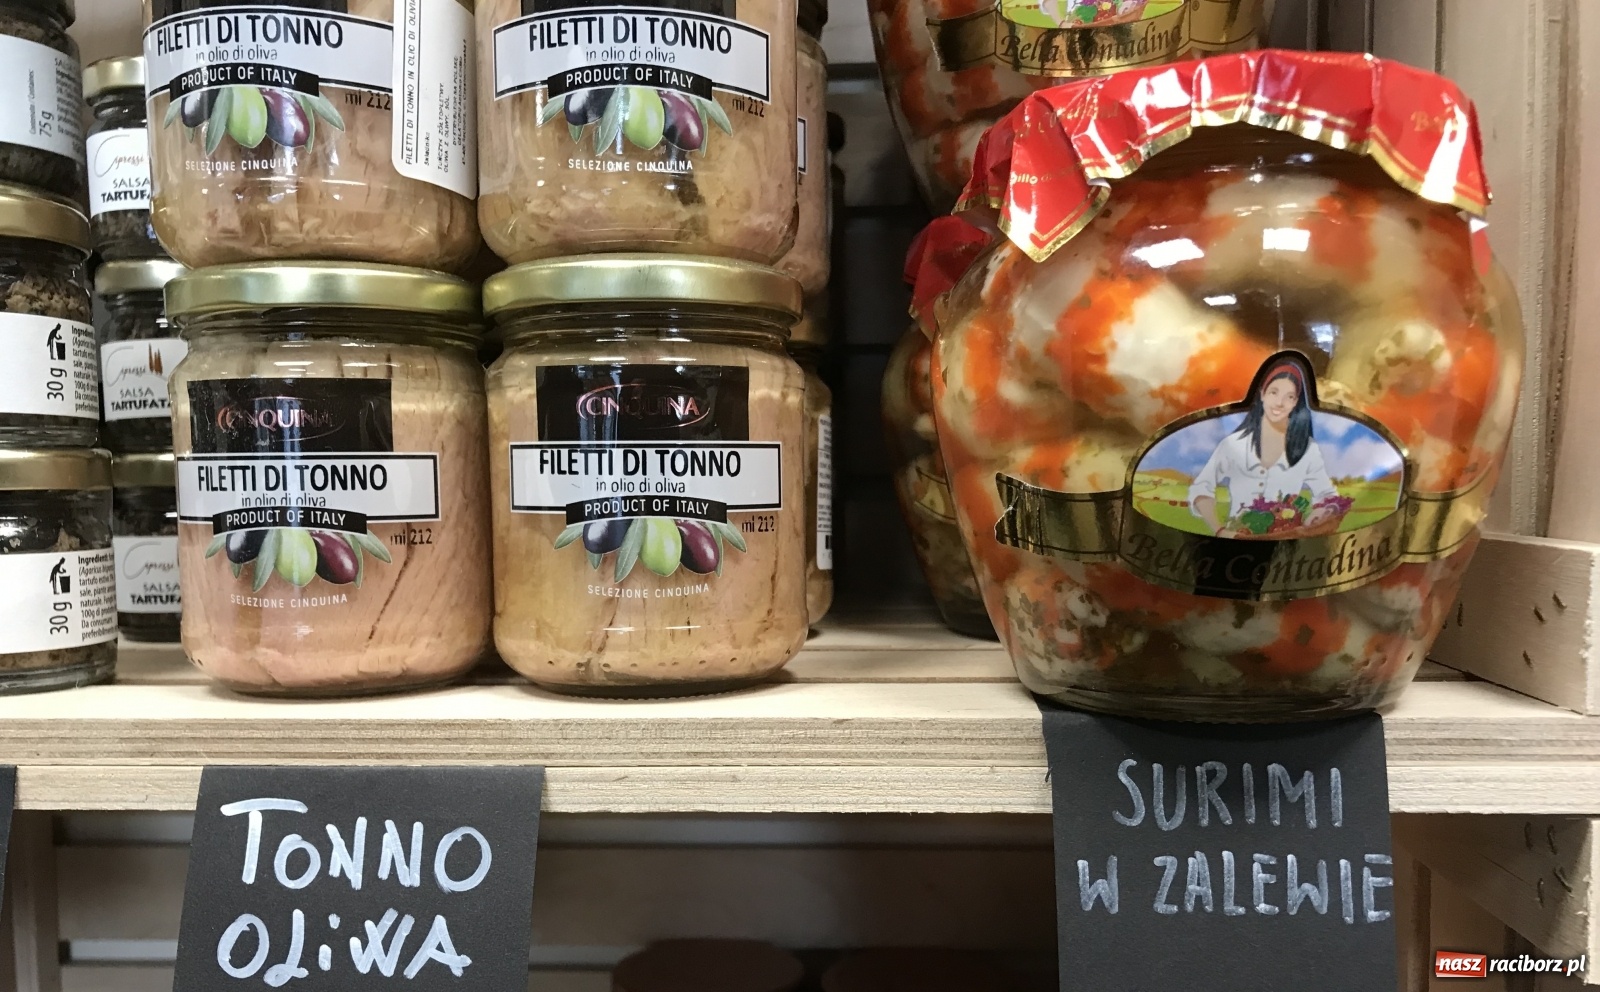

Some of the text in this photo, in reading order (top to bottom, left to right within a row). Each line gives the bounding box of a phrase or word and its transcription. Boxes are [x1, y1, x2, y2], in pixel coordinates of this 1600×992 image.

[157, 14, 343, 56] FILETTI DI TONNO
[408, 30, 415, 41] DI
[529, 16, 732, 54] FILETTI DI TONNO
[196, 44, 278, 63] in olio di oliva
[586, 45, 676, 63] in olio di oliva
[1001, 29, 1059, 64] Bella
[181, 66, 297, 90] PRODUCT OF ITALY
[407, 70, 415, 80] IN
[565, 66, 694, 89] PRODUCT OF ITALY
[367, 90, 391, 111] 212
[407, 83, 415, 114] TONNO
[748, 96, 765, 118] 212
[39, 110, 55, 137] 75 g
[406, 119, 414, 129] DI
[405, 132, 413, 165] FILETTI
[185, 160, 236, 171] SELEZIONE
[568, 158, 694, 172] SELEZIONE CINQUINA
[112, 177, 150, 189] SALSA
[46, 367, 67, 401] 30 g
[120, 387, 155, 399] SALSA
[74, 390, 81, 400] Da
[585, 395, 700, 420] CINQUINA
[539, 449, 741, 478] FILETTI DI TONNO
[198, 464, 388, 492] FILETTI DI TONNO
[596, 478, 686, 494] in olio di oliva
[241, 494, 250, 507] in
[280, 492, 292, 507] di
[295, 493, 326, 507] oliva
[584, 498, 709, 517] PRODUCT OF ITALY
[226, 509, 346, 526] PRODUCT OF ITALY
[742, 515, 755, 533] ml
[410, 528, 433, 545] 212
[1128, 533, 1393, 584] Bella Contadina
[80, 587, 93, 597] sale,
[143, 581, 181, 593] SALSA
[587, 583, 710, 599] SELEZIONE CINQUINA
[230, 593, 348, 609] SELEZIONE CINQUINA
[50, 601, 72, 635] 30 g
[81, 609, 95, 620] 100g
[81, 619, 90, 629] Da
[1112, 758, 1343, 831] SURIMI
[1077, 850, 1394, 924] W ZALEWIE
